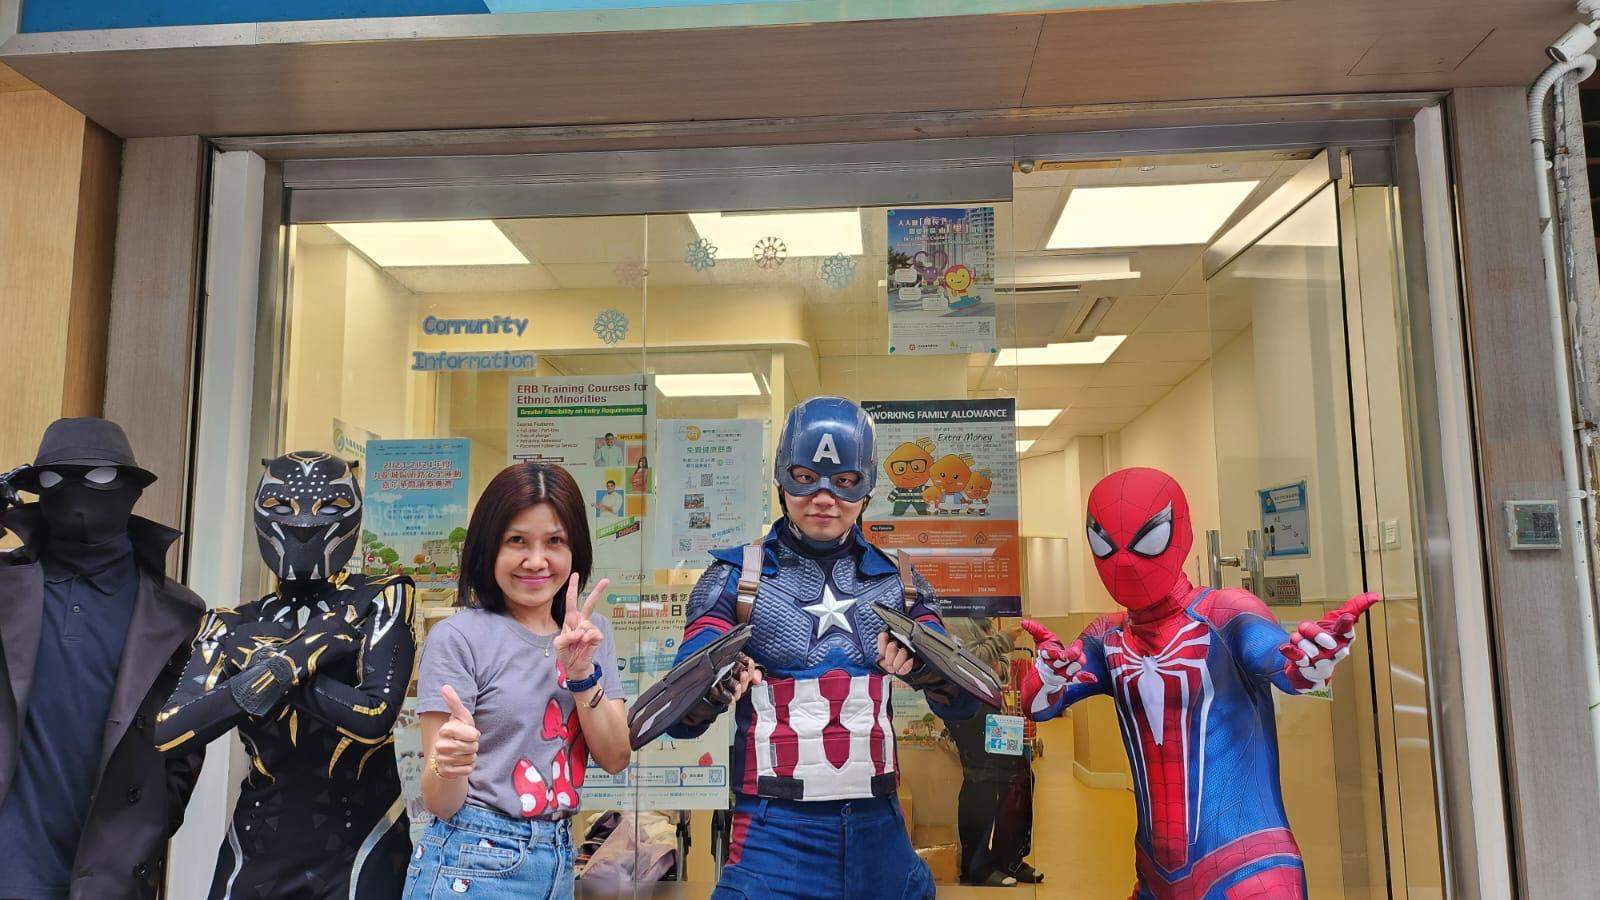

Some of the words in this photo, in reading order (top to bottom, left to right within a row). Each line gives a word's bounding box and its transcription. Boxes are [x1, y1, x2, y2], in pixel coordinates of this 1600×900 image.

[422, 315, 528, 336] Community
[411, 351, 536, 371] Information
[517, 384, 539, 394] ERB
[541, 384, 584, 395] Training
[587, 383, 631, 393] Courses
[633, 382, 648, 392] for
[517, 395, 551, 404] Ethnic
[553, 394, 607, 404] Minorities
[544, 408, 574, 416] Flexibility
[584, 407, 600, 415] Entry
[602, 406, 643, 415] Requirements
[871, 410, 915, 420] WORKING
[917, 410, 949, 419] FAMILY
[951, 409, 1007, 418] ALLOWANCE
[938, 433, 961, 441] Extra
[963, 432, 993, 442] Money
[812, 433, 841, 464] A
